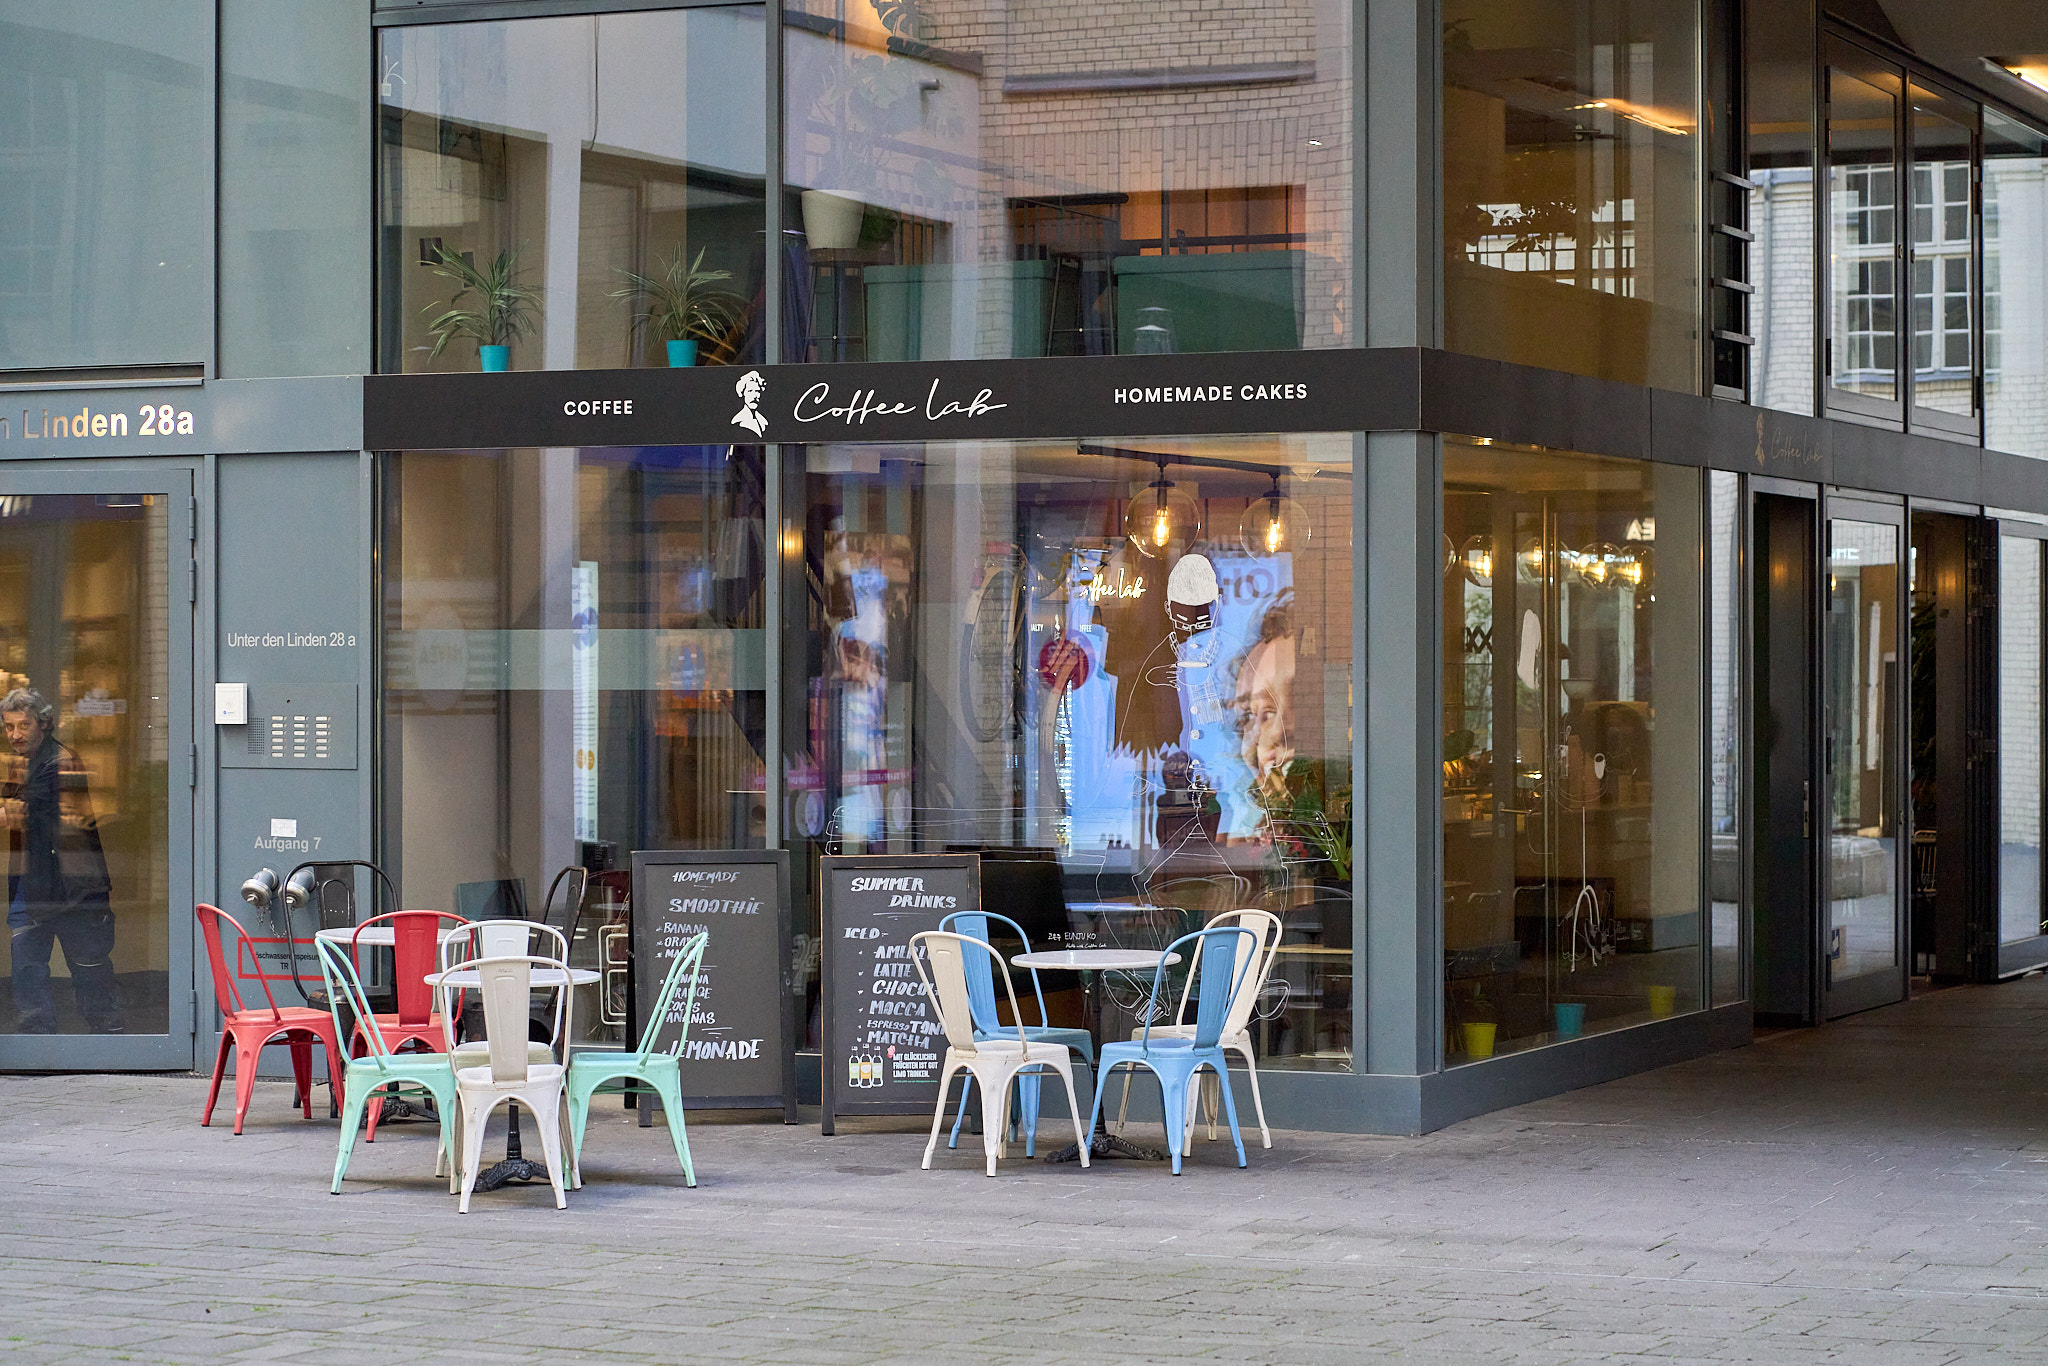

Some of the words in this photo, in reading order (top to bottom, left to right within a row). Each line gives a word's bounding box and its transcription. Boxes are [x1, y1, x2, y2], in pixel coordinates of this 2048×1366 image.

[1114, 385, 1233, 404] HOMEMADE
[1240, 383, 1308, 401] CAKES
[563, 400, 633, 416] COFFEE
[793, 383, 916, 425] Coffee
[23, 407, 128, 439] Linden
[138, 404, 194, 436] 28a
[227, 632, 259, 647] Unter
[262, 632, 285, 647] den
[287, 632, 327, 647] Linden
[329, 631, 345, 647] 28
[347, 635, 356, 647] a
[254, 836, 309, 852] Aufgang
[313, 837, 322, 849] 7
[672, 871, 740, 884] HOMEMADE
[850, 877, 925, 892] SUMMER
[668, 897, 764, 915] SMOOTHIE
[888, 892, 957, 909] DRINKS
[663, 921, 709, 934] BANANA
[873, 962, 915, 978] LATTE
[869, 1000, 926, 1017] MOCCA
[867, 1030, 930, 1050] MATCHA
